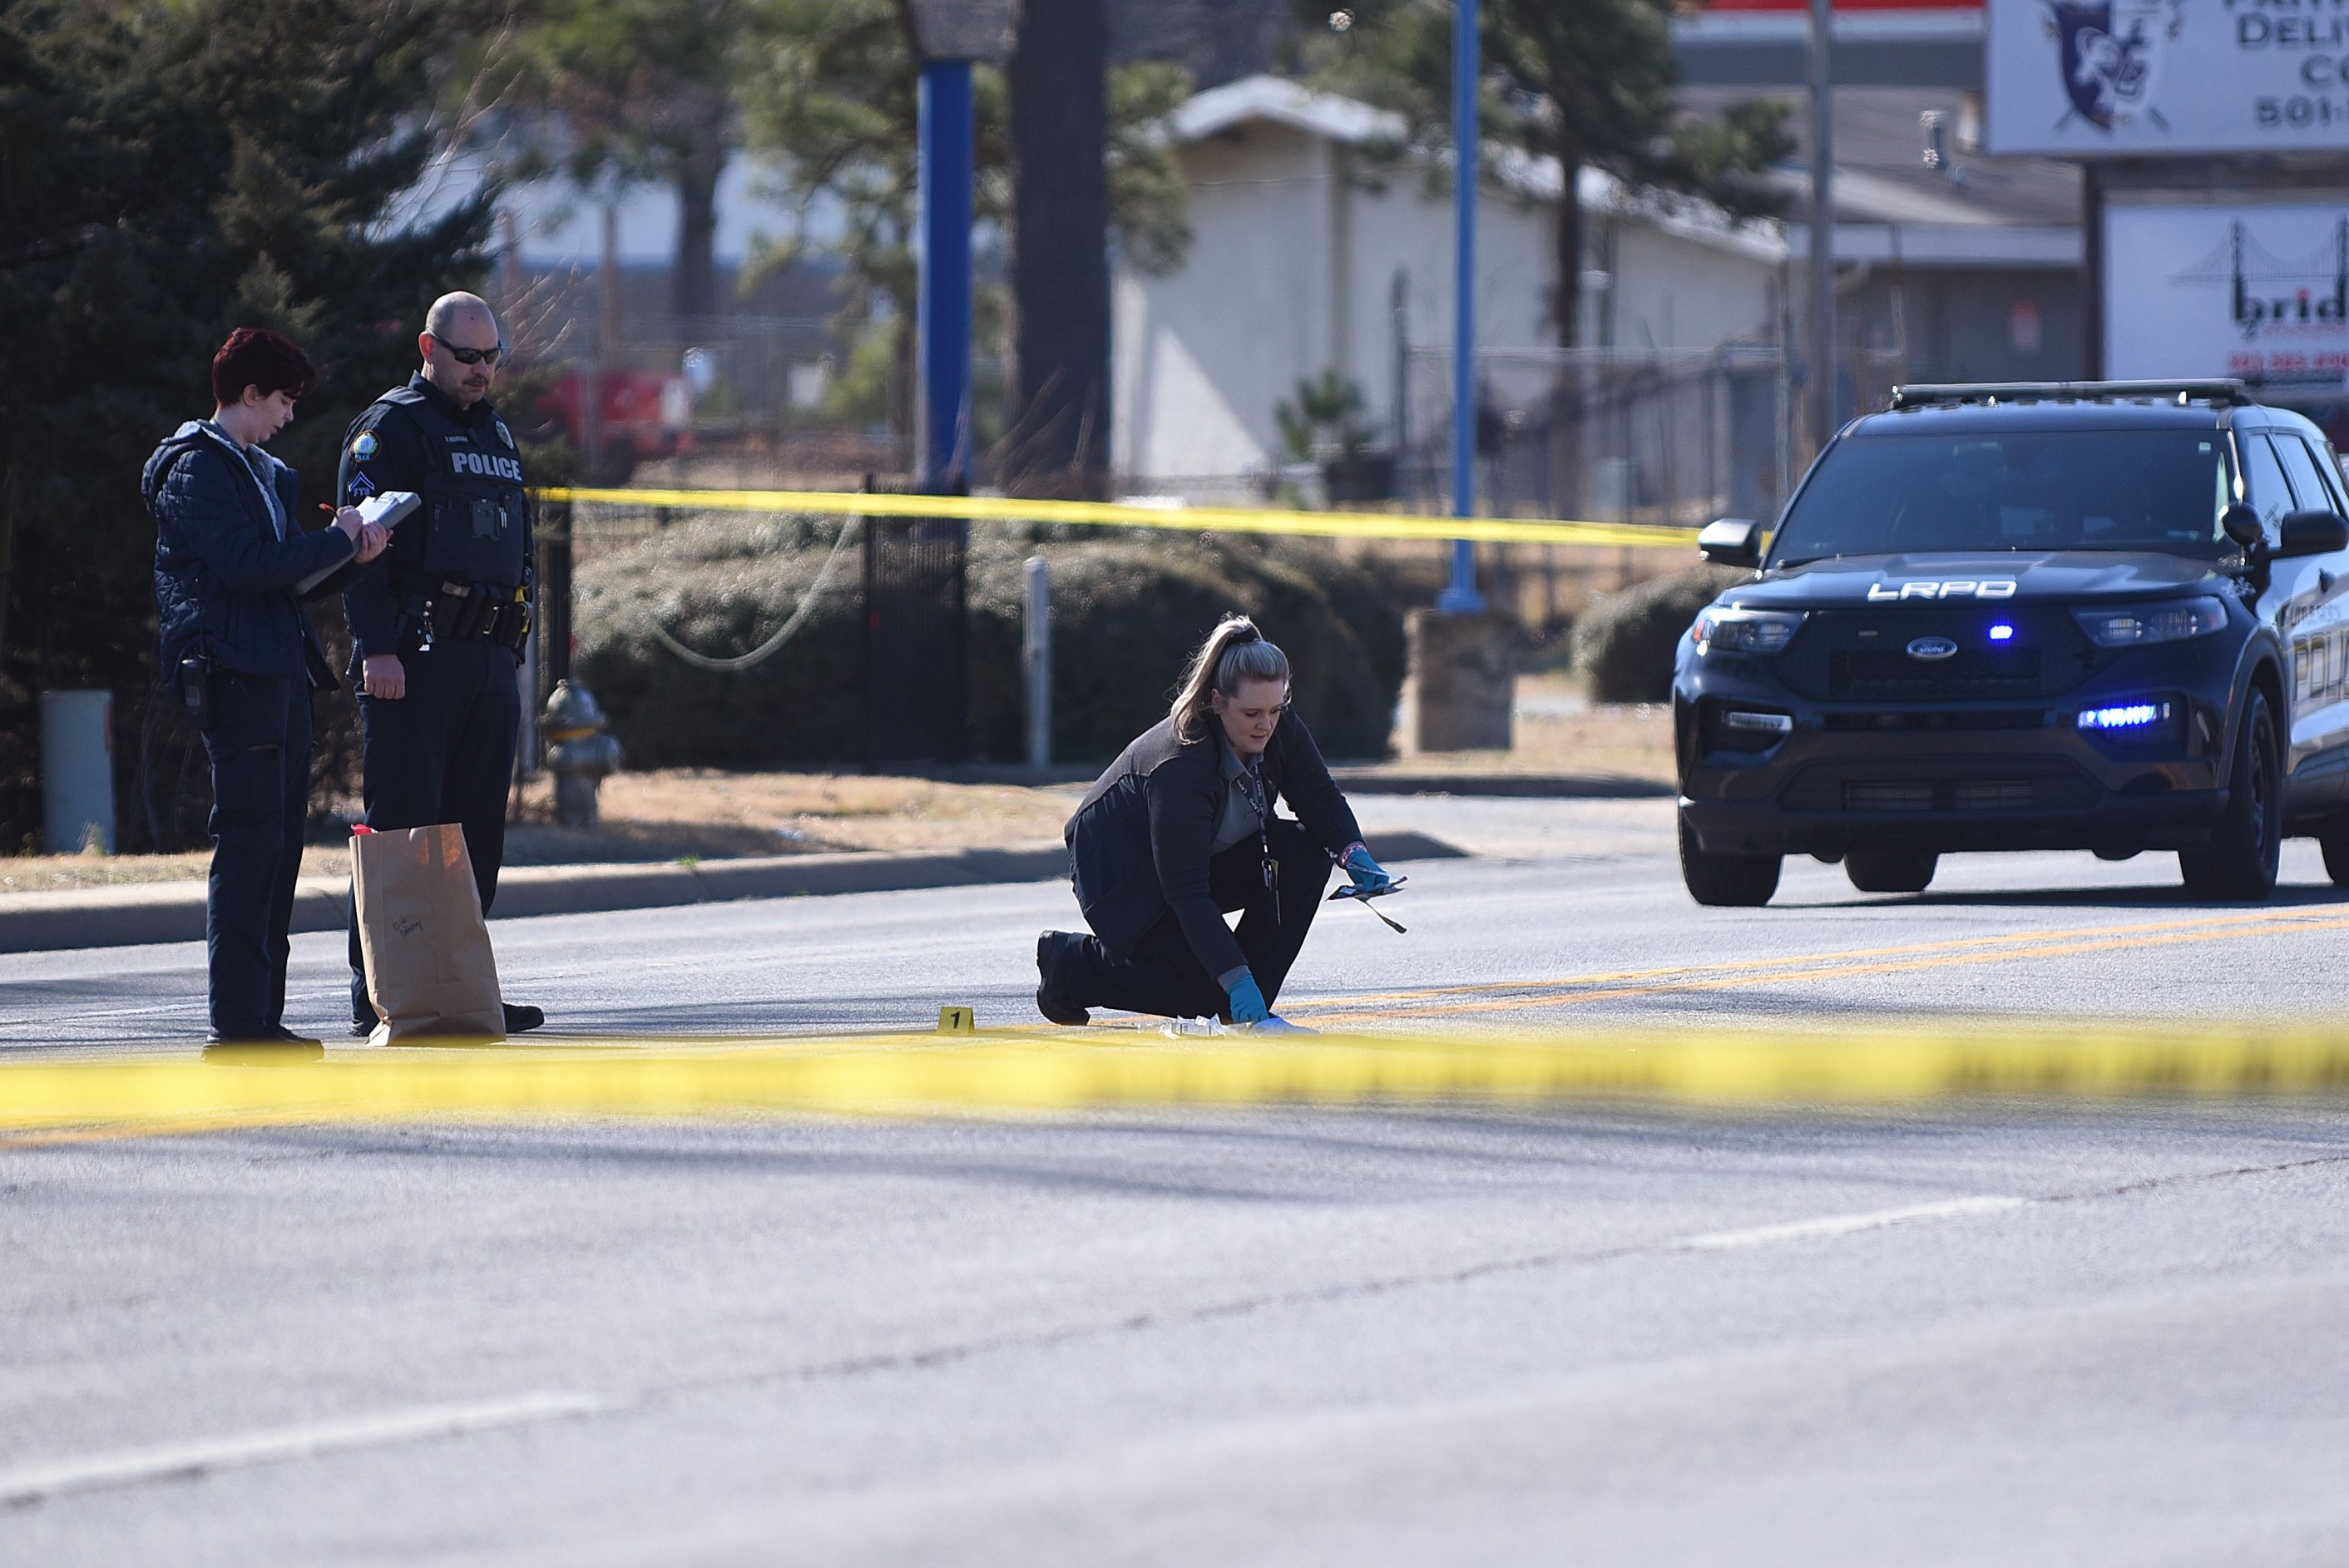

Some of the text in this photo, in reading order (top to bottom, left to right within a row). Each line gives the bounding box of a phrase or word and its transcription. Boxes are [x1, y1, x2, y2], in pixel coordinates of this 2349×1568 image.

[2237, 12, 2349, 47] DELI
[451, 452, 522, 482] POLICE
[1867, 581, 2017, 602] LRPD
[950, 1011, 961, 1029] 1
